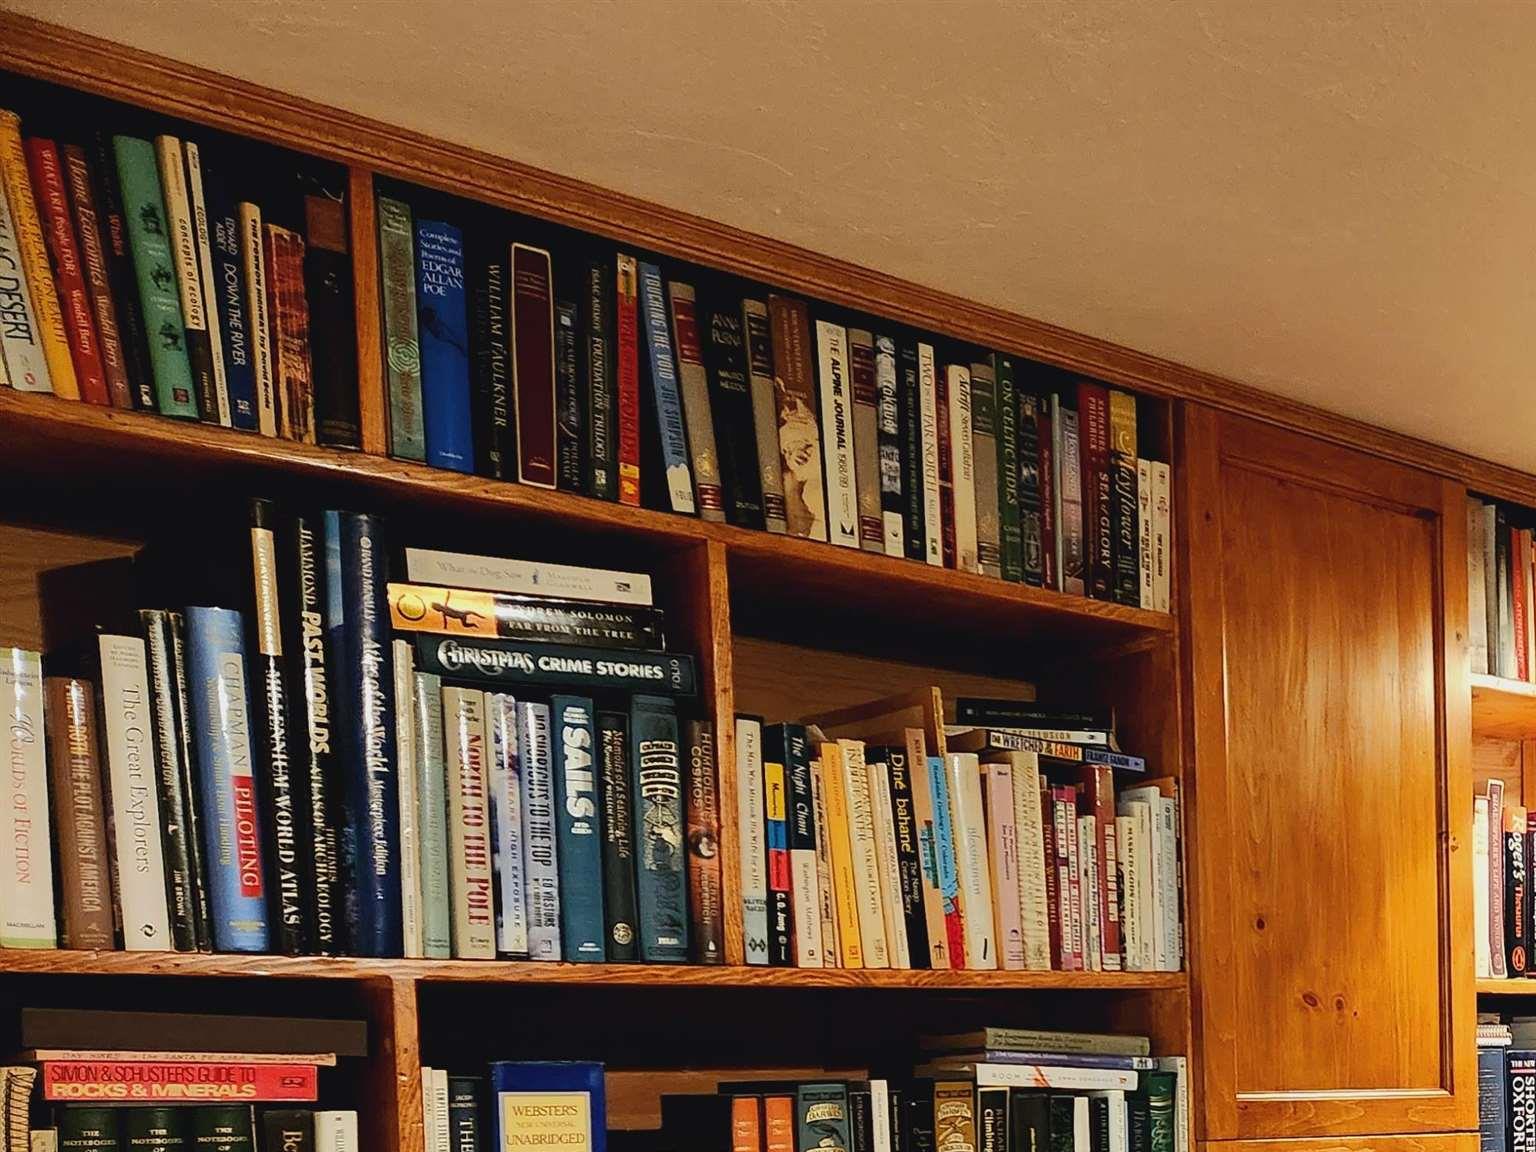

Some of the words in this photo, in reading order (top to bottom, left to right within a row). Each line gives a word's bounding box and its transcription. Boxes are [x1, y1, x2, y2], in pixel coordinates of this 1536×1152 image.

[224, 263, 239, 304] DOWN
[422, 260, 464, 279] EDGAR
[422, 272, 463, 290] ALLAN
[423, 283, 447, 297] POE
[488, 263, 504, 337] WILLIAM
[1, 276, 34, 346] DESERT
[228, 304, 243, 331] THE
[231, 330, 246, 366] RIVER
[490, 341, 507, 428] FAULKNER
[1002, 379, 1015, 402] ON
[1003, 404, 1017, 459] CELTIC
[1005, 459, 1018, 506] TIDES
[509, 621, 532, 632] FAR
[535, 623, 571, 636] FROM
[574, 625, 600, 638] THE
[604, 630, 635, 641] TREE
[437, 639, 537, 677] CHRISTMAS
[538, 655, 593, 675] CRIME
[596, 660, 664, 680] STORIES
[670, 658, 681, 690] FOLIO
[121, 684, 140, 721] The
[222, 660, 248, 767] CHAPMAN
[124, 724, 144, 780] Great
[791, 736, 805, 756] The
[1002, 732, 1045, 753] WRETCHED
[1054, 745, 1080, 760] EARTH
[459, 732, 484, 802] NORTH
[562, 726, 595, 819] SAILS
[792, 763, 809, 798] Night
[126, 784, 152, 874] Explorers
[273, 790, 296, 866] WORLD
[463, 803, 485, 828] TO
[797, 801, 809, 838] Chant
[234, 786, 259, 888] PILOTING
[464, 833, 488, 872] THE
[1507, 814, 1526, 885] Roget's
[279, 869, 301, 927] ATLAS
[466, 876, 491, 927] POLE
[51, 1065, 98, 1083] SIMON
[101, 1066, 113, 1083] &
[198, 1066, 237, 1083] GUIDE
[240, 1066, 256, 1083] TO
[51, 1084, 128, 1098] ROCKS
[129, 1084, 149, 1098] &
[151, 1084, 257, 1098] MINERALS
[512, 1105, 578, 1118] WEBSTER'S
[506, 1132, 585, 1147] UNABRIDGED
